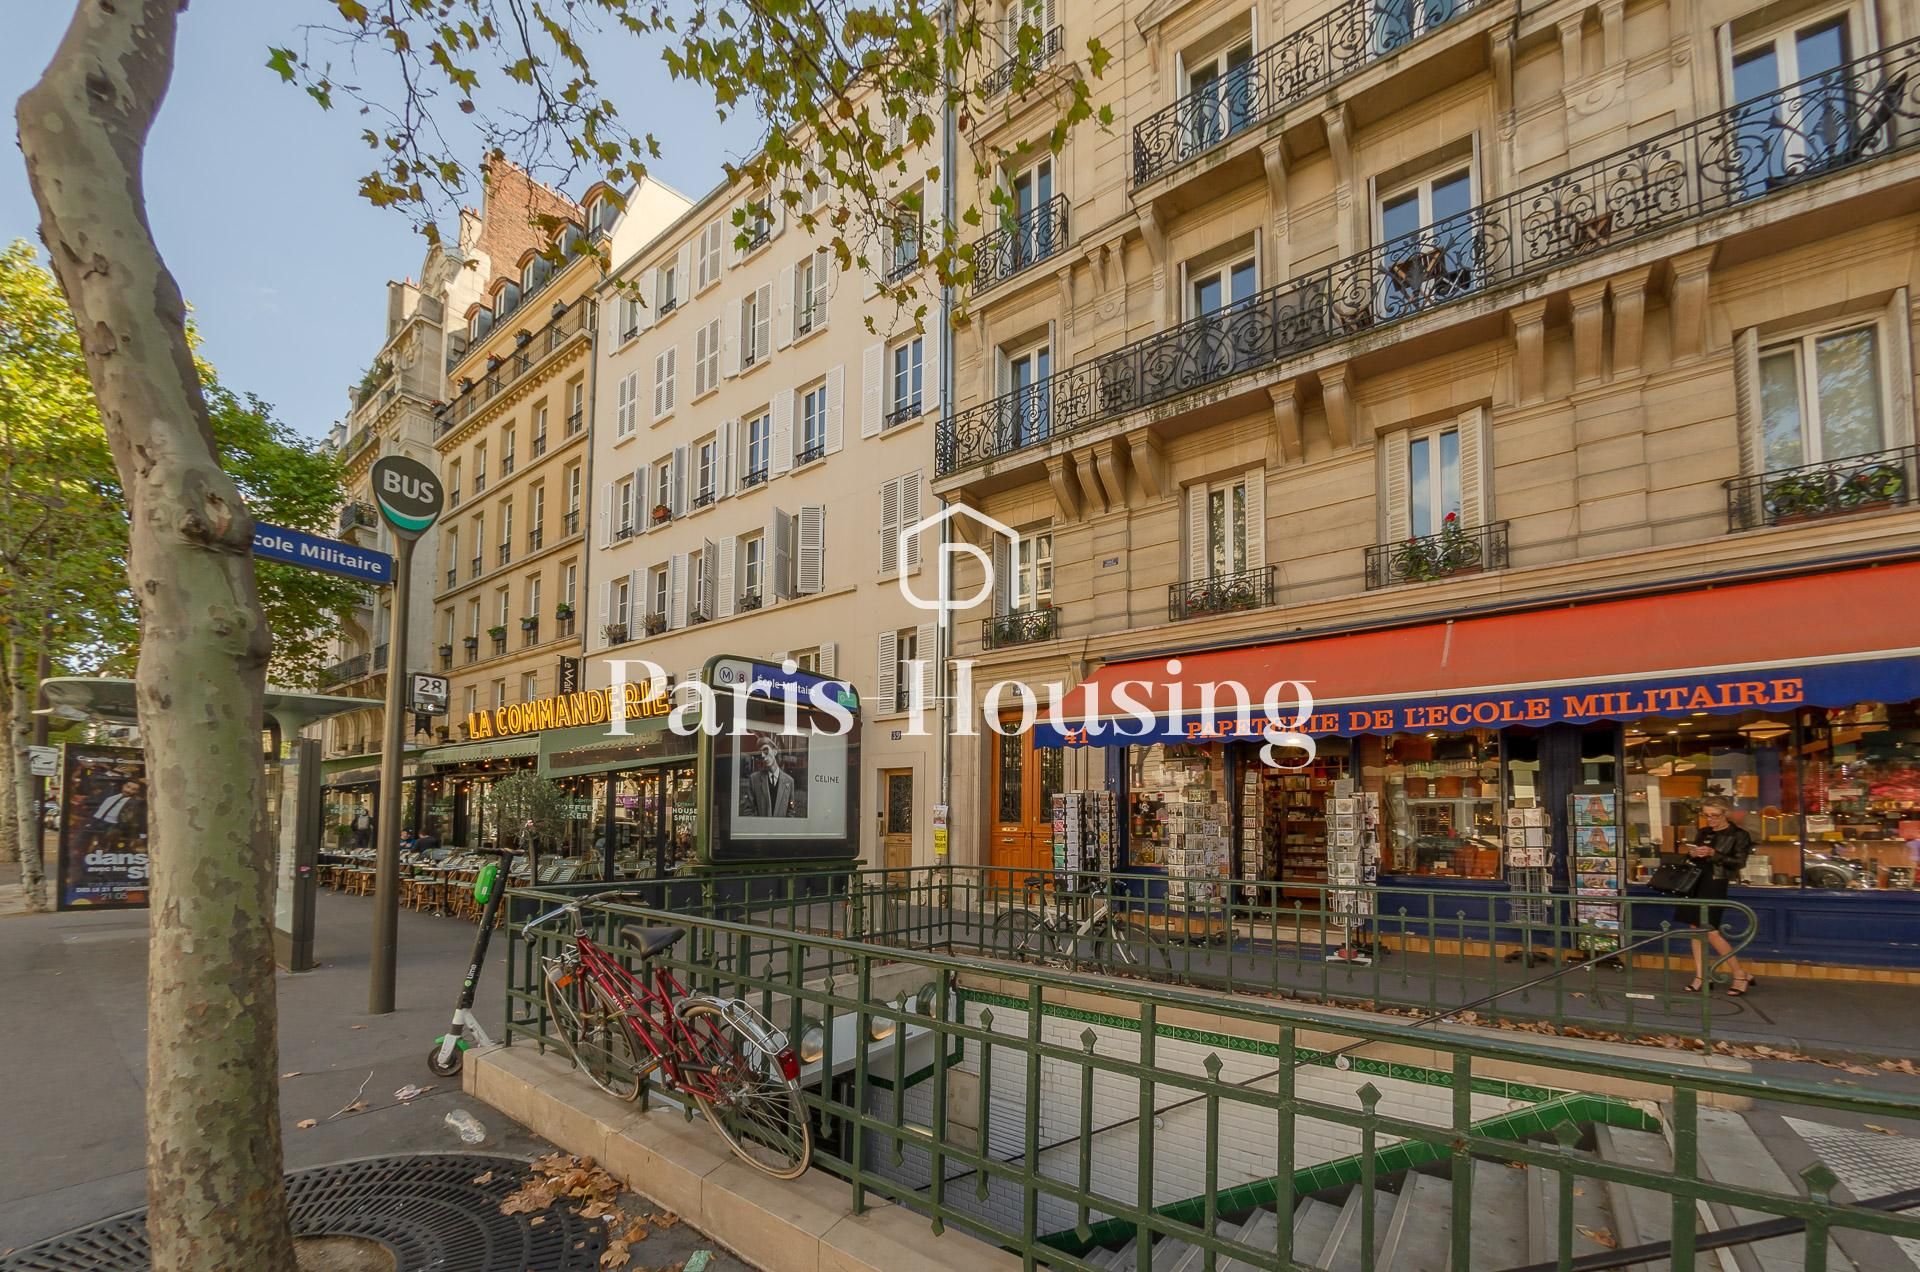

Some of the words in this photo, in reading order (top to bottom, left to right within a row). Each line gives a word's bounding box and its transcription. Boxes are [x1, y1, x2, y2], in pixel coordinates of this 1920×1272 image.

[383, 469, 434, 503] BUS
[253, 533, 294, 553] cole
[300, 542, 383, 574] Militaire
[419, 678, 442, 693] 28
[739, 674, 745, 682] 8
[468, 709, 493, 740] LA
[496, 677, 671, 736] COMMANDERIE
[1186, 713, 1339, 740] PAPETERIE
[1349, 709, 1394, 731] DE
[1404, 698, 1550, 728] L'ECOLE
[1563, 677, 1803, 718] MILITAIRE
[1064, 727, 1089, 744] 41
[85, 850, 150, 865] dans
